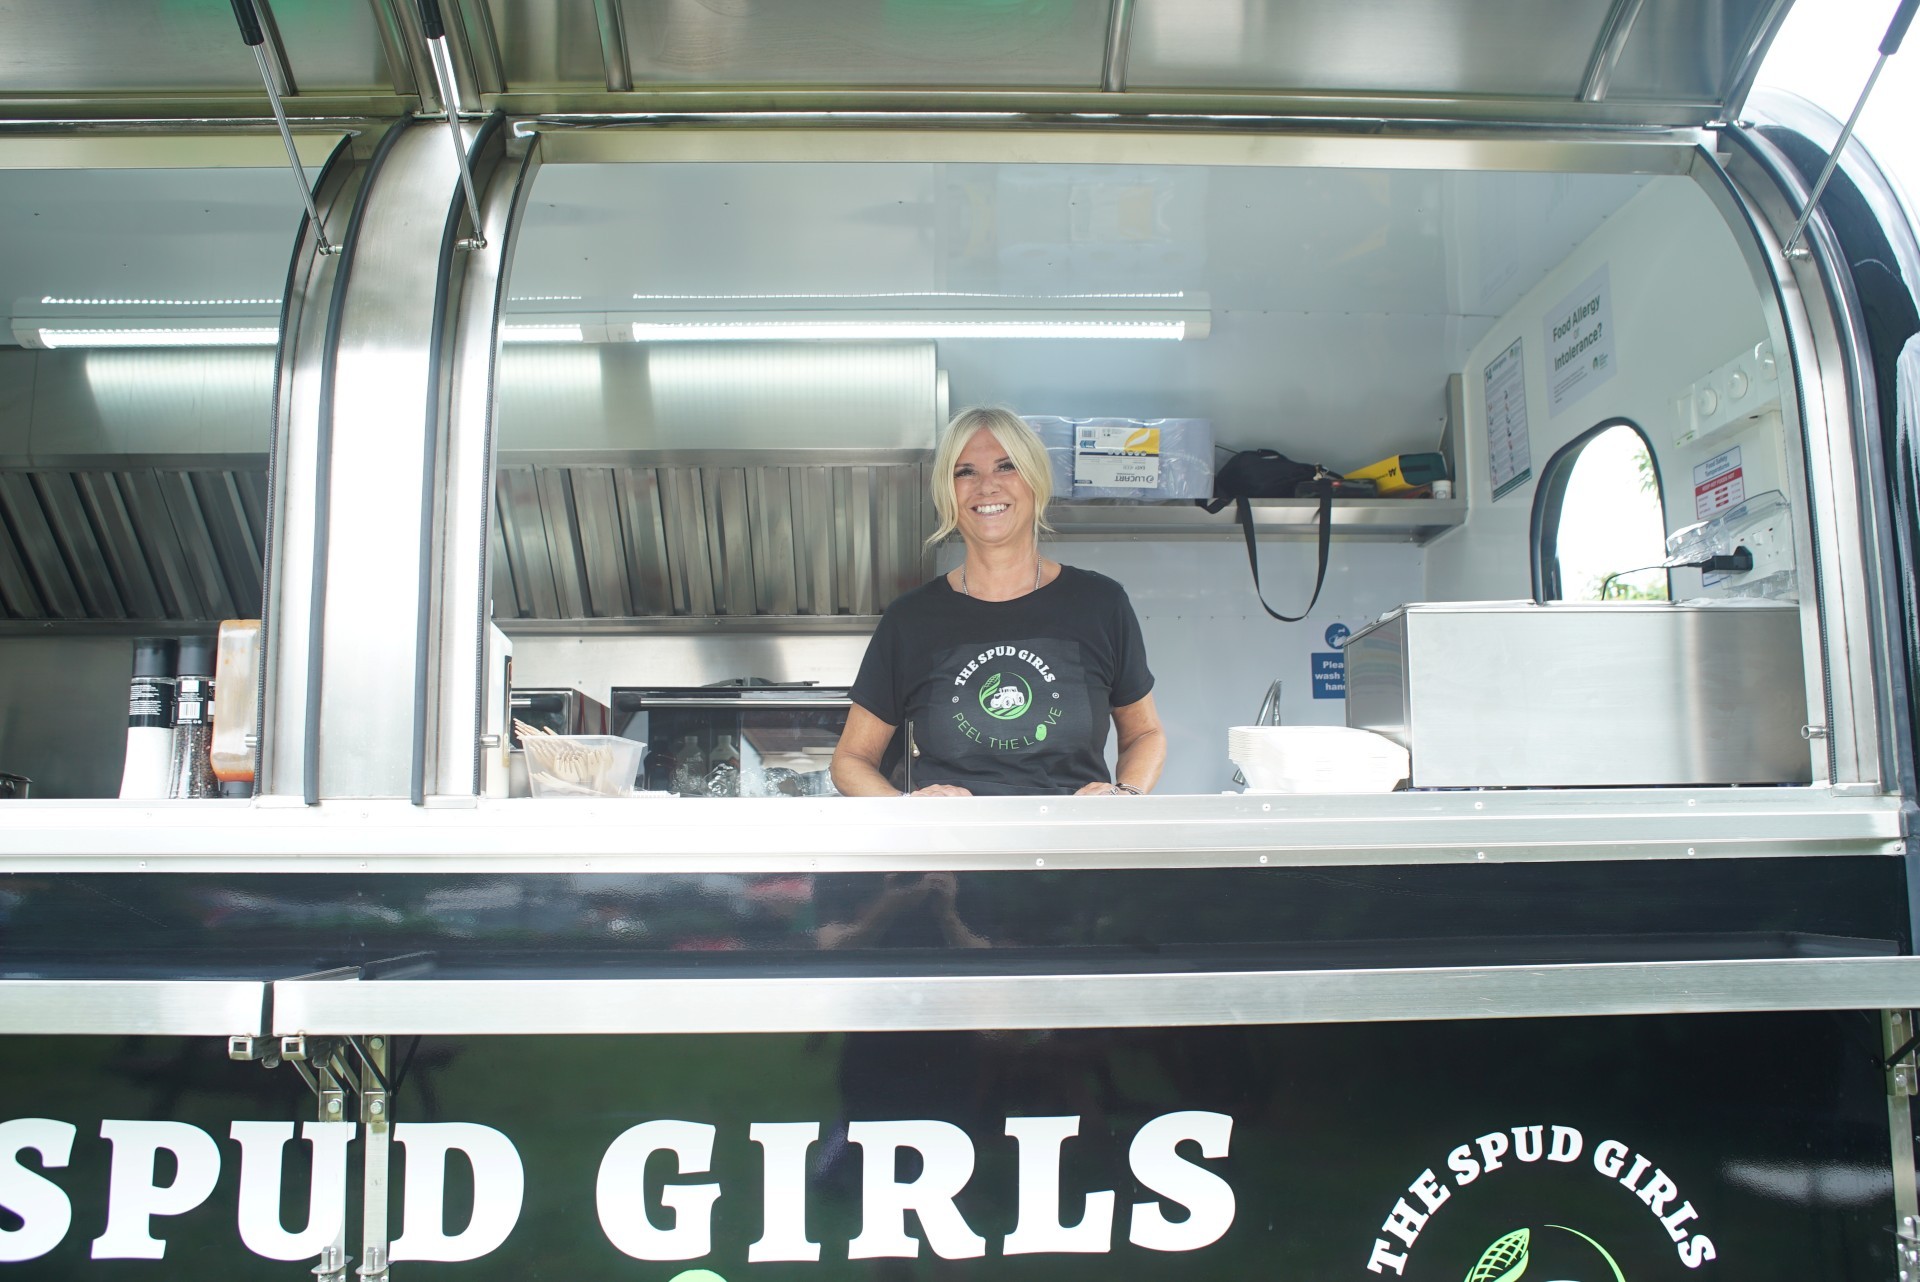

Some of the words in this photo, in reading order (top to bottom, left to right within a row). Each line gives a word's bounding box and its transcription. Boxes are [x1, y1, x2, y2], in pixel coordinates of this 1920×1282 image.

[1553, 316, 1571, 342] Food
[1572, 294, 1600, 327] Allergy
[1554, 322, 1602, 371] Intolerance?
[954, 660, 979, 686] THE
[977, 646, 1016, 664] SPUD
[1018, 649, 1056, 683] GIRLS
[1315, 672, 1340, 680] wash
[1322, 661, 1344, 669] Plea
[1325, 683, 1345, 691] han
[952, 712, 982, 744] PEEL
[988, 736, 1020, 750] THE
[0, 1117, 524, 1262] SPUD
[596, 1111, 1235, 1263] GIRLS
[1367, 1168, 1451, 1276] THE
[1447, 1125, 1583, 1186] SPUD
[1593, 1139, 1717, 1268] GIRLS
